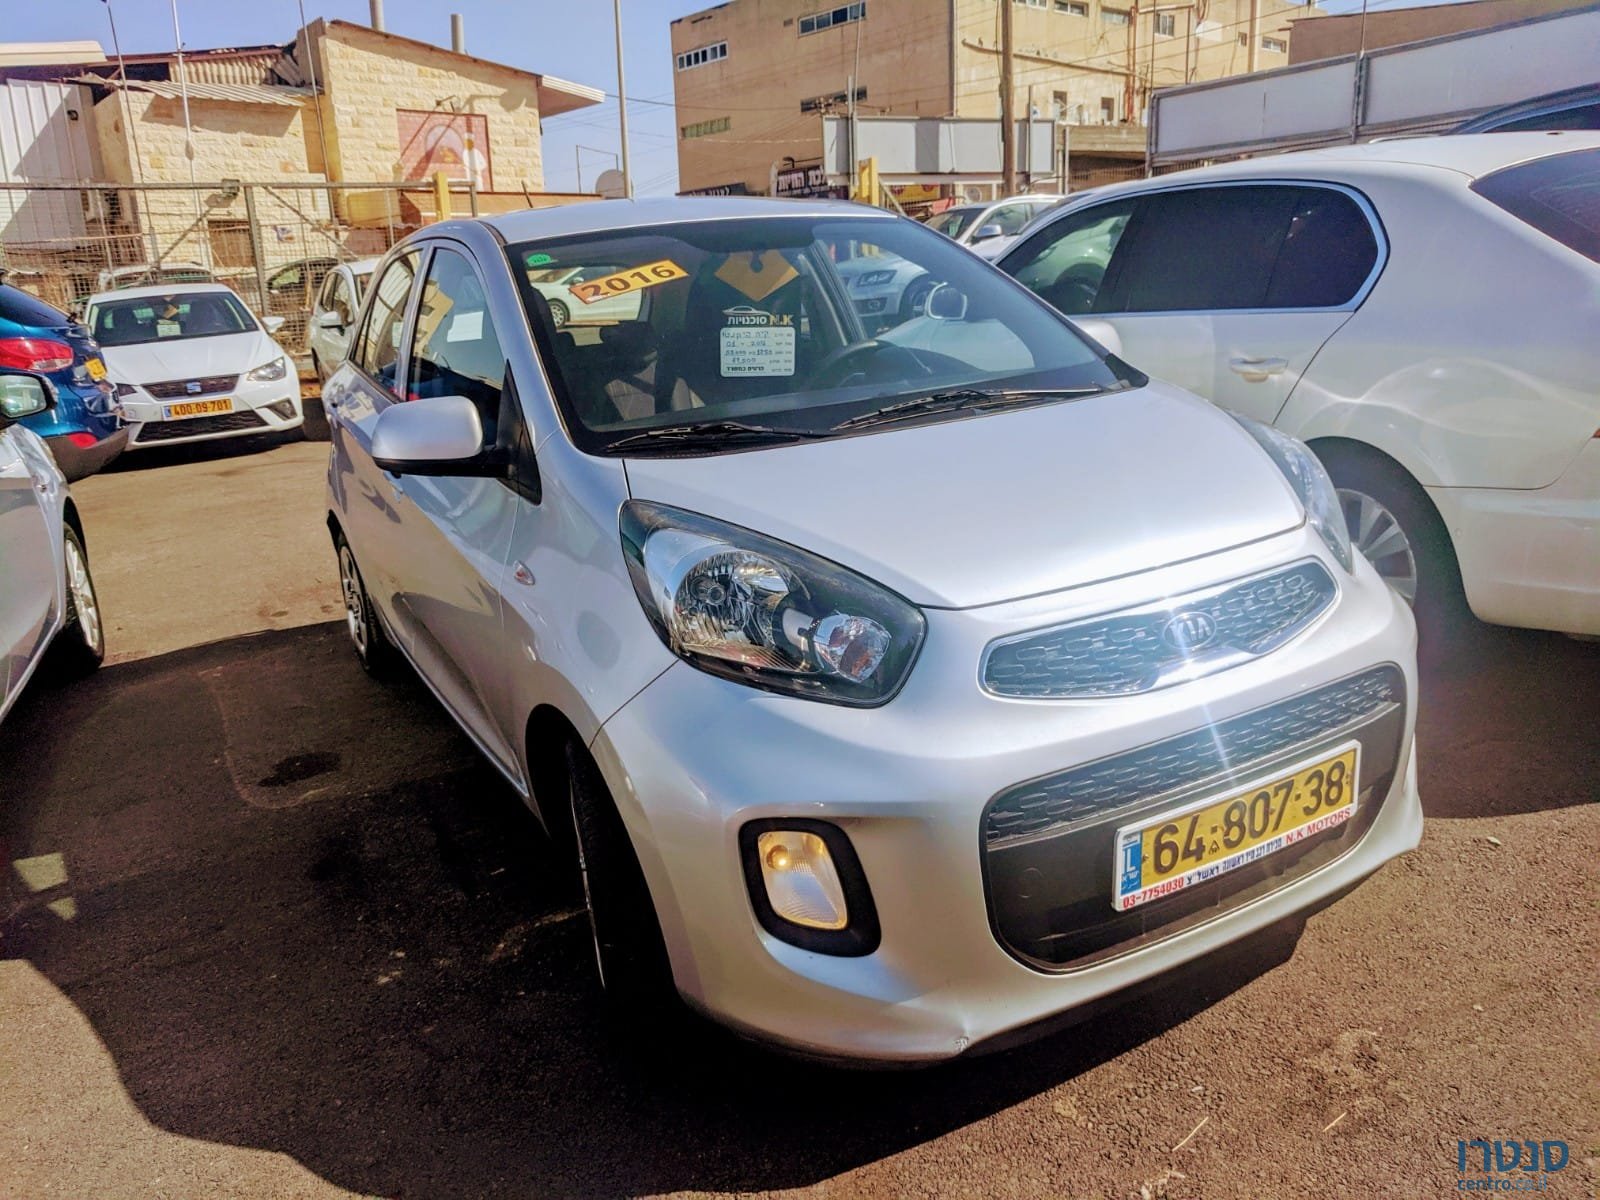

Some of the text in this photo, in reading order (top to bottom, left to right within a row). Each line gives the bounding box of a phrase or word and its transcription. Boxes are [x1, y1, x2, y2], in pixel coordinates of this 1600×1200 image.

[581, 265, 675, 298] 2016
[173, 400, 229, 416] 400-09-701
[1170, 617, 1212, 646] KIA
[1153, 760, 1346, 874] 64-807-38
[1307, 807, 1351, 836] MOTORS
[1122, 877, 1185, 909] 03-7754030
